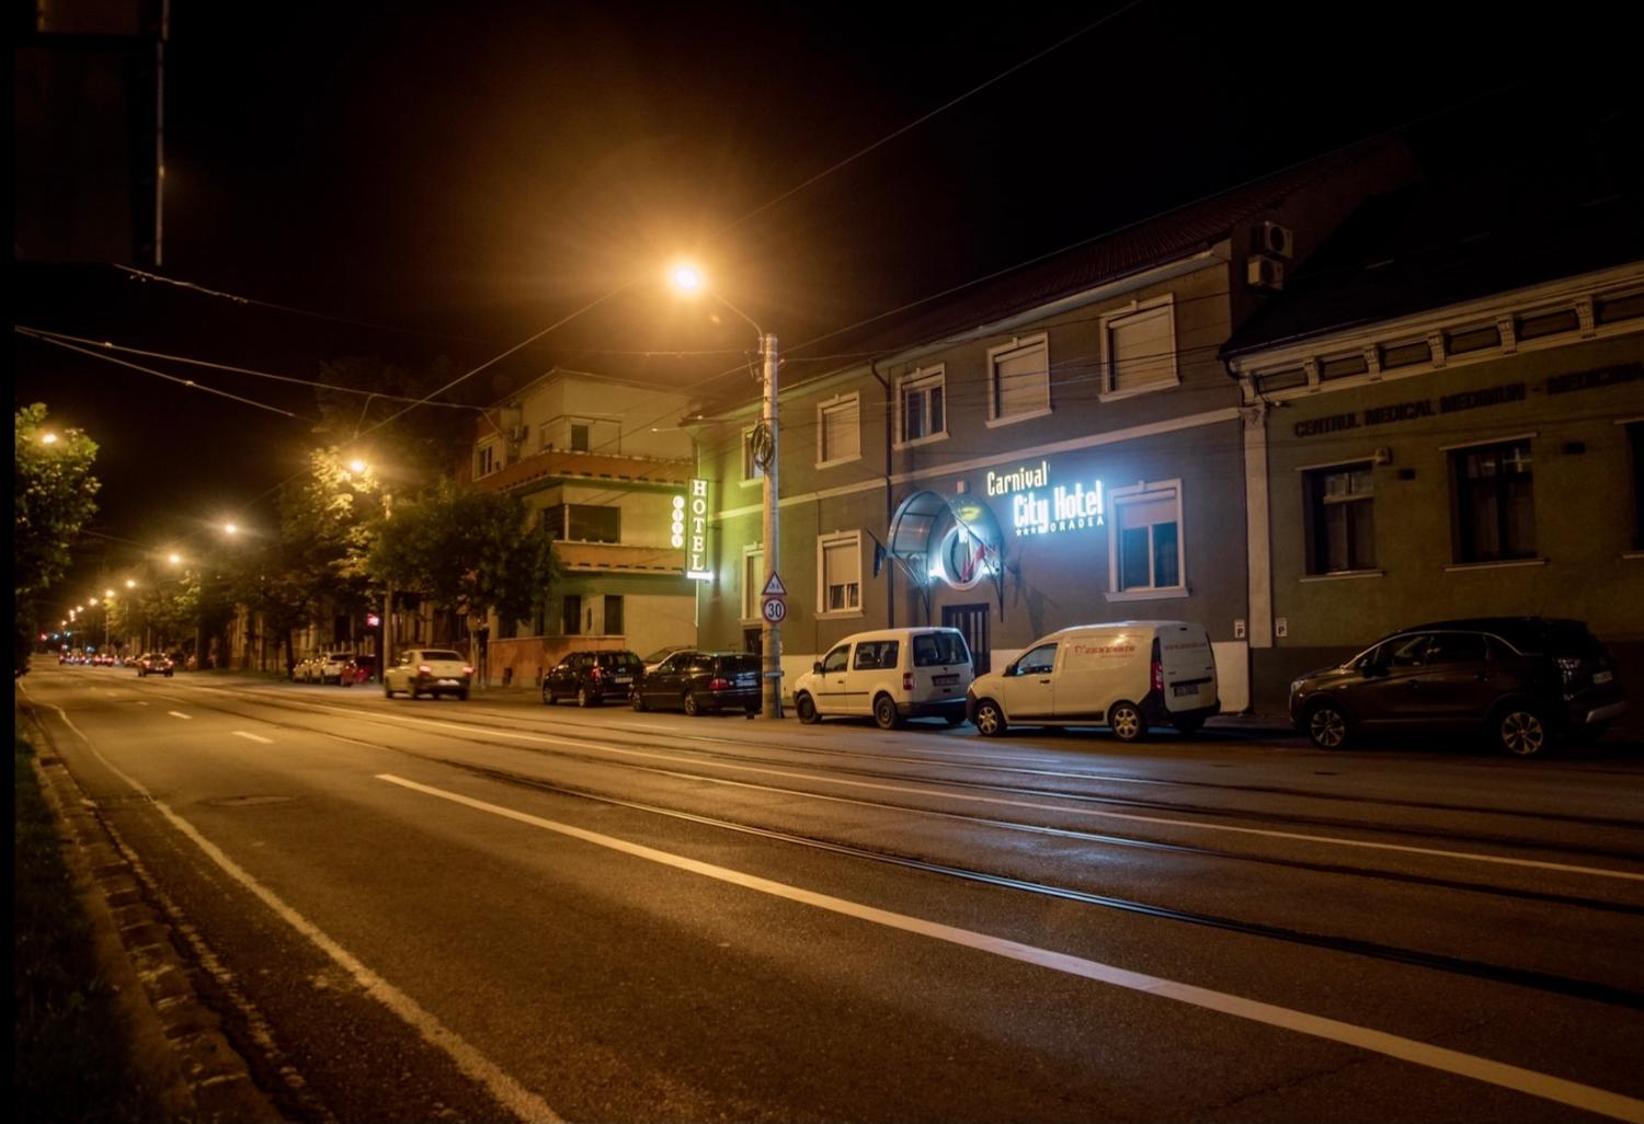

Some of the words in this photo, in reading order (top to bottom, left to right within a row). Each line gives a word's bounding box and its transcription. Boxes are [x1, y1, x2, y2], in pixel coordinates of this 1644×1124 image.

[1294, 412, 1361, 438] CENTRUL
[1364, 399, 1436, 426] MEDICAL
[987, 460, 1048, 496] Carnival
[692, 479, 708, 571] HOTEL
[1013, 491, 1049, 534] City
[1054, 479, 1104, 521] Hotel
[1050, 516, 1104, 533] ORADEA
[768, 602, 782, 618] 30
